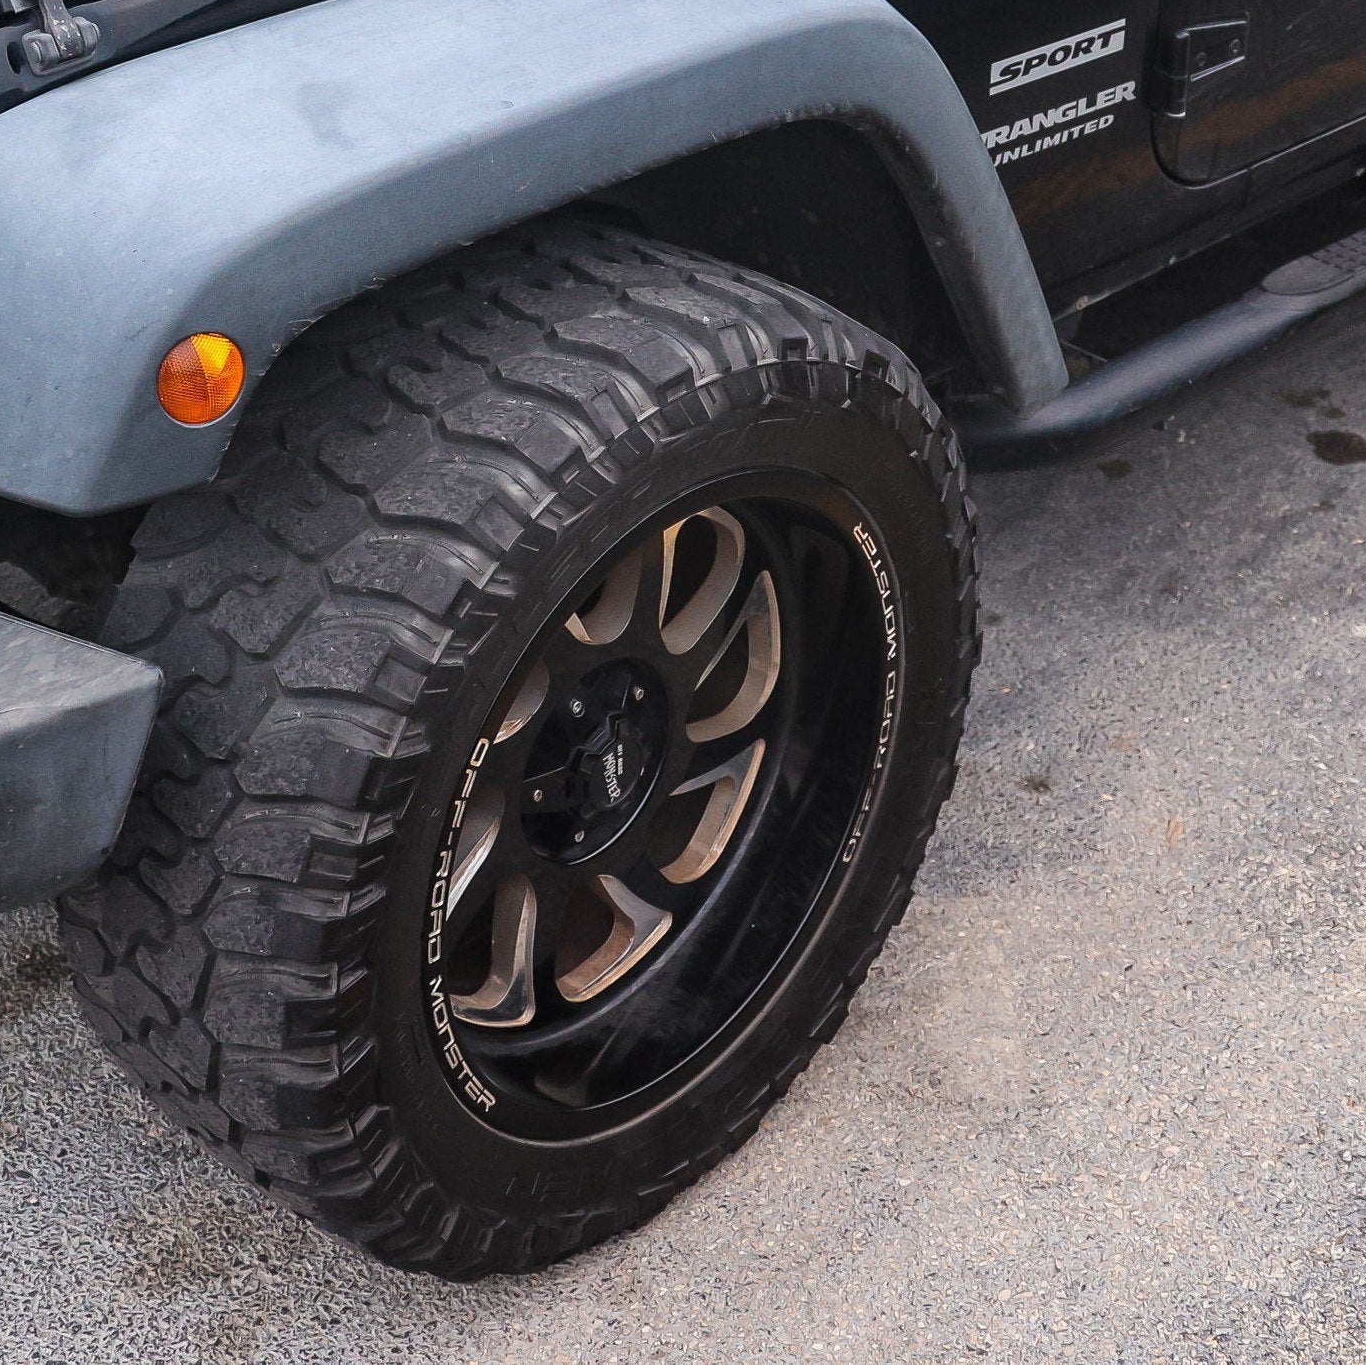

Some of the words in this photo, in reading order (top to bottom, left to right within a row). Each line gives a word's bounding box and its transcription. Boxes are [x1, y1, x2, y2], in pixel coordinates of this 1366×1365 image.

[980, 81, 1136, 149] RANGLER
[990, 23, 1126, 89] SPORT
[853, 521, 897, 661] MONSTER
[428, 738, 490, 965] OFF-ROAD
[429, 974, 496, 1113] MONSTER
